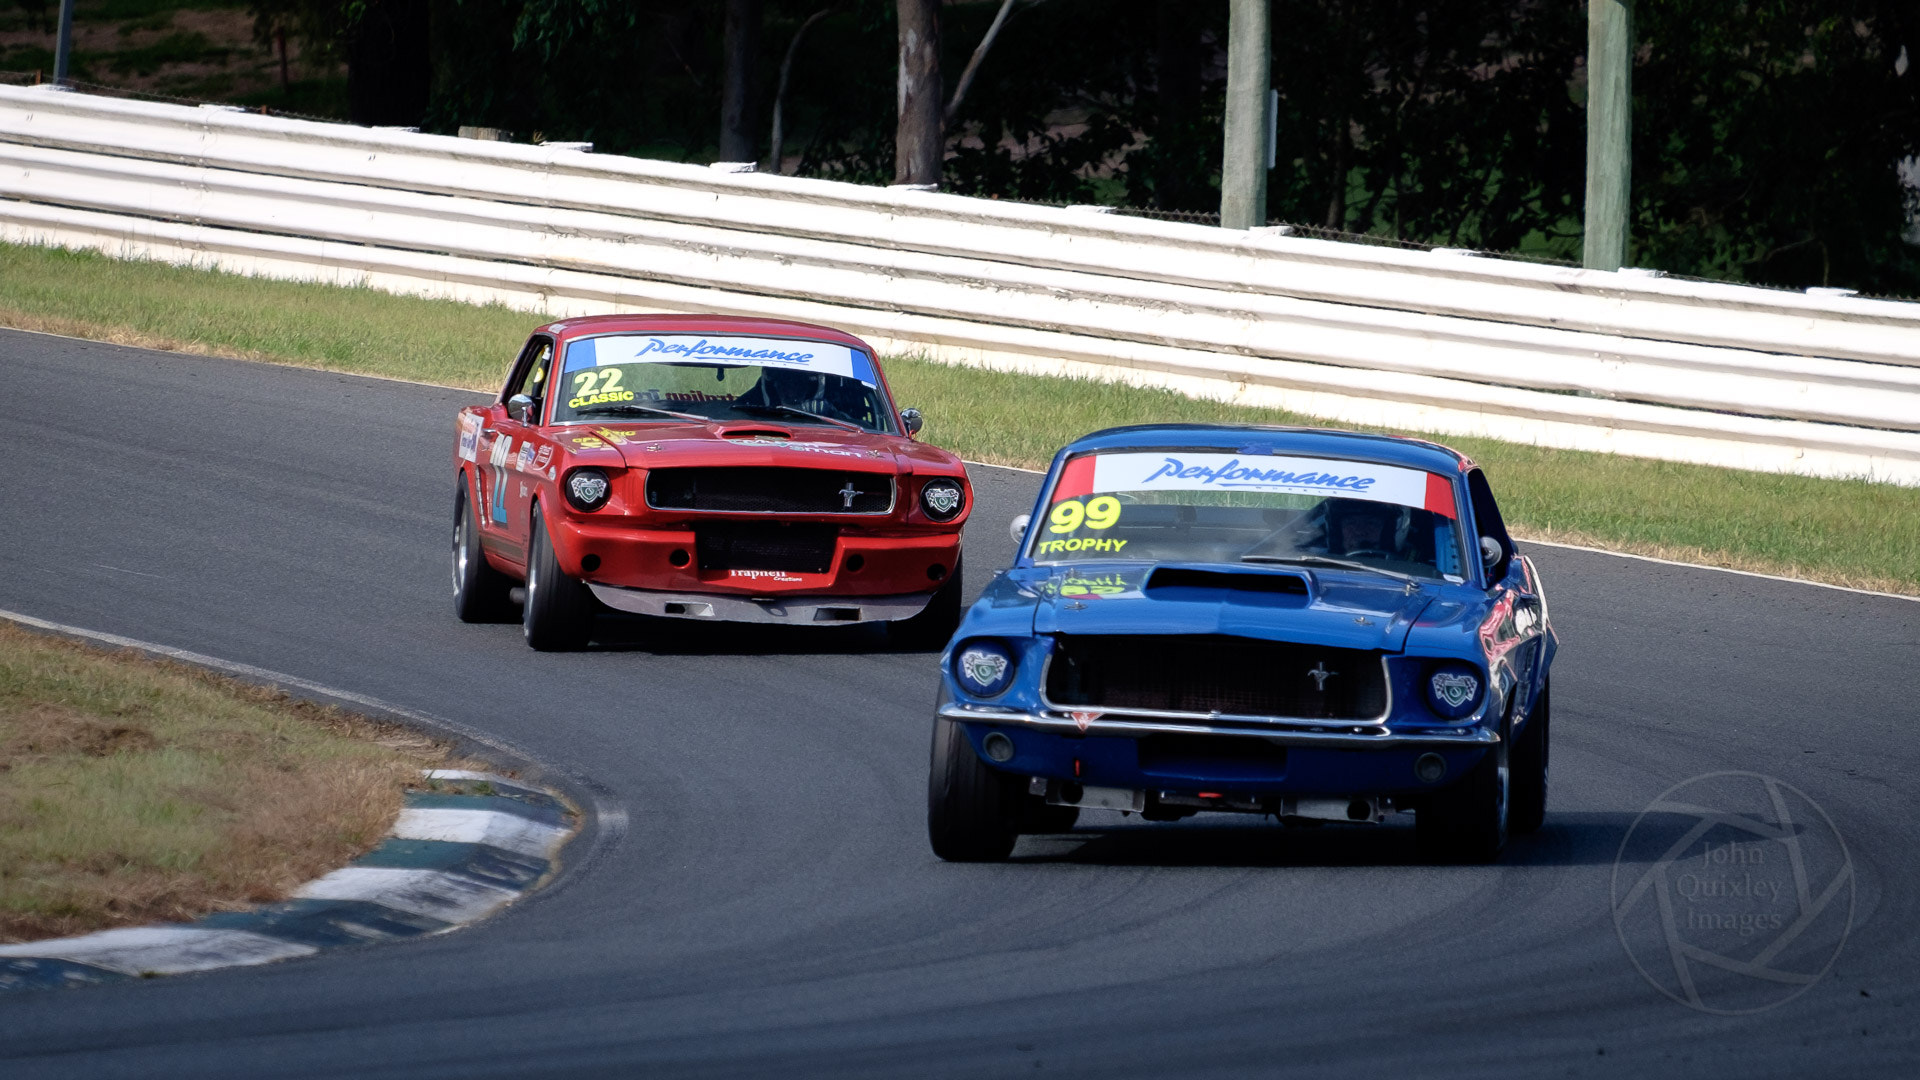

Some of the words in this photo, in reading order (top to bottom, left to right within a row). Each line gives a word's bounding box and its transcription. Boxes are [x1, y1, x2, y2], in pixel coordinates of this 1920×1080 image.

[635, 338, 814, 363] Performance
[574, 368, 624, 398] 22
[568, 390, 634, 408] CLASSIC
[1142, 458, 1376, 490] Performance
[1049, 496, 1121, 534] 99
[1039, 538, 1127, 554] TROPHY
